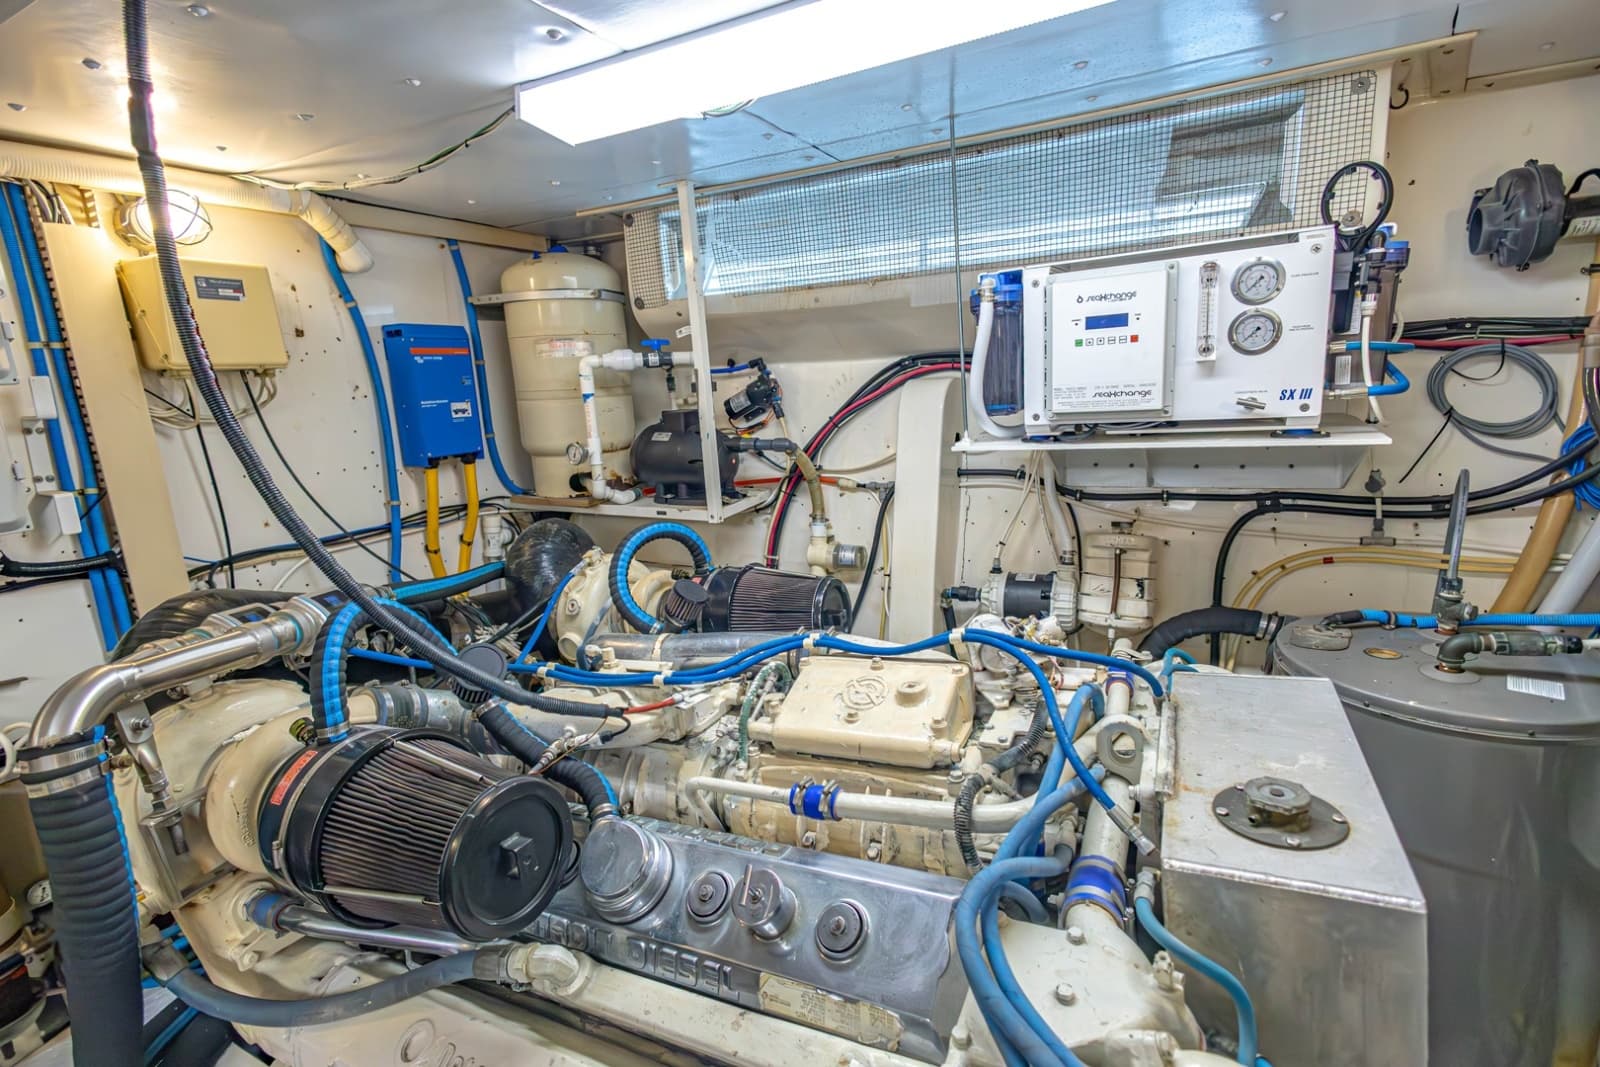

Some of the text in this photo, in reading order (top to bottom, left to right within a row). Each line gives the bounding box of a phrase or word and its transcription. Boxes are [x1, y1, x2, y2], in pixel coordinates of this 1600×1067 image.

[1279, 387, 1314, 401] SX III
[626, 937, 740, 1001] DIESEL
